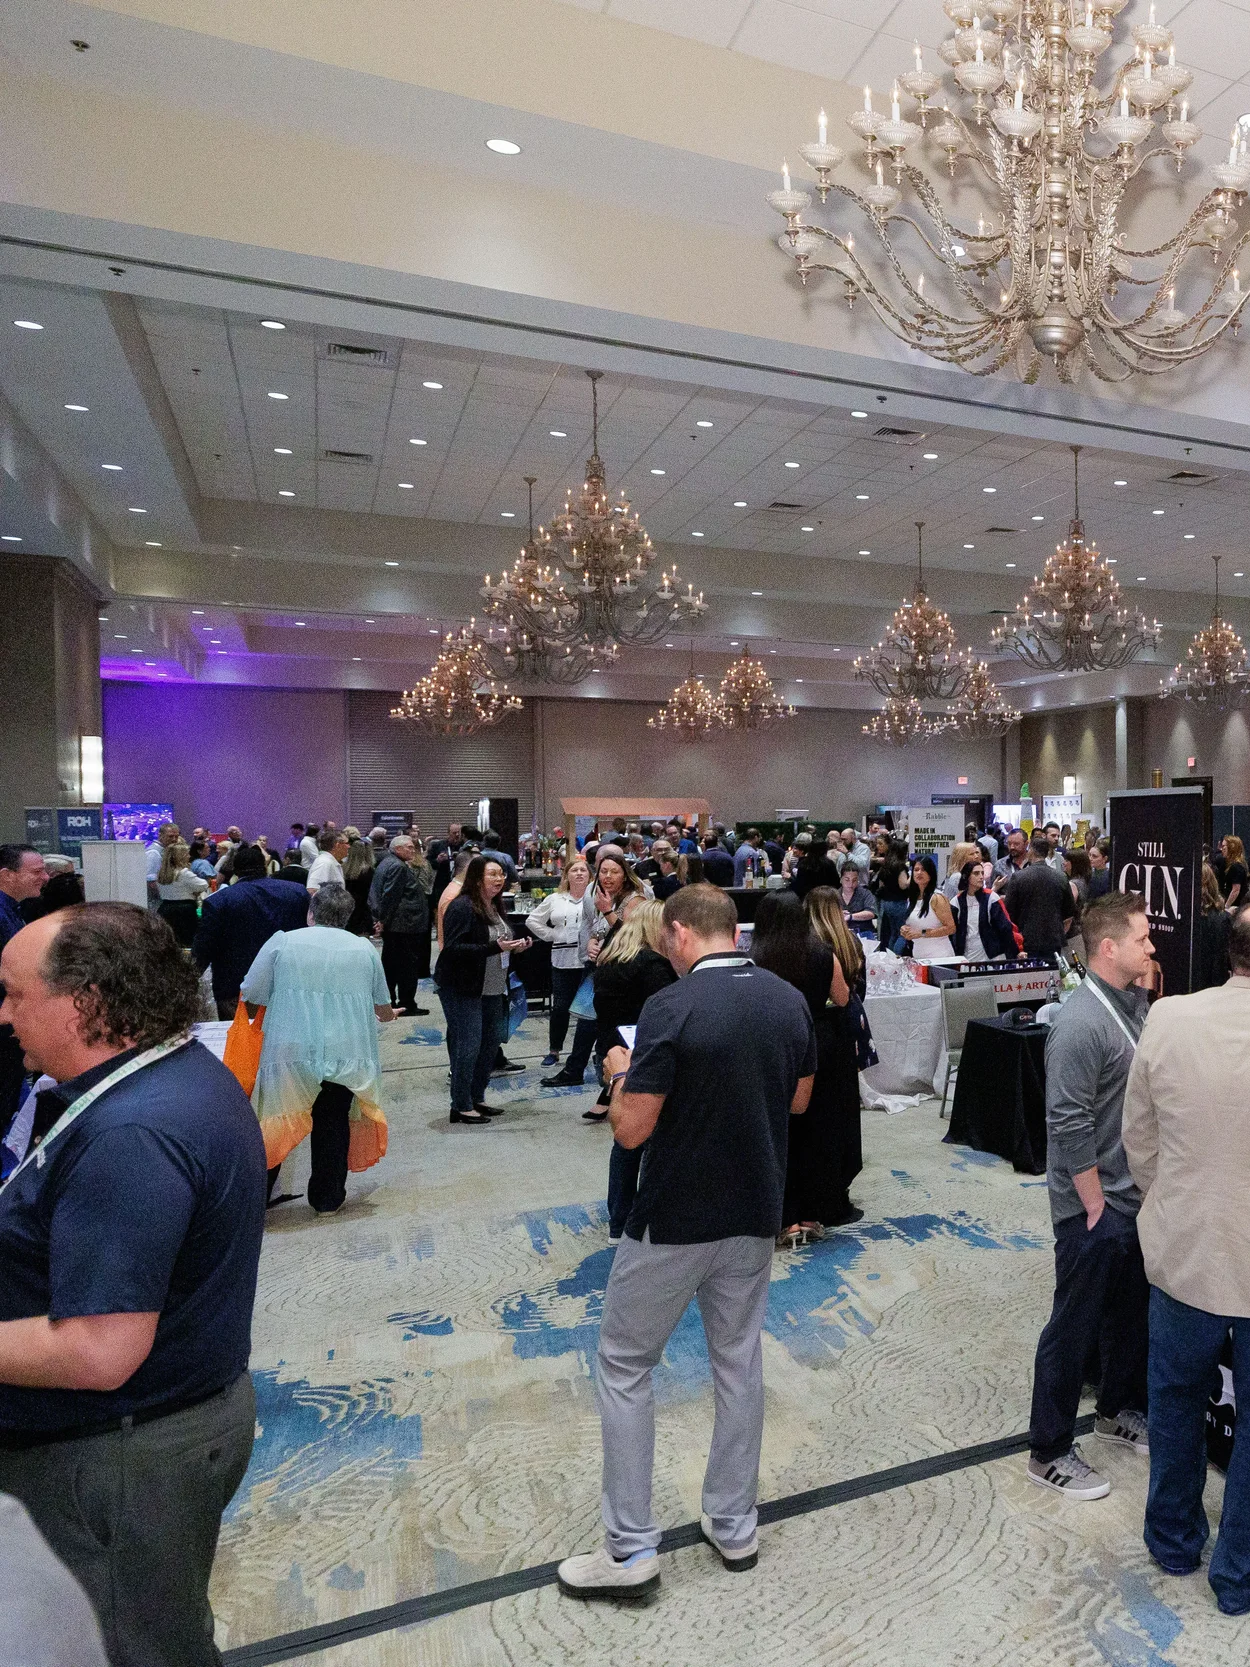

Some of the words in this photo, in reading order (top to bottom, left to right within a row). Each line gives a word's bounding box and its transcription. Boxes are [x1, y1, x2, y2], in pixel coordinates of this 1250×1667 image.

[67, 816, 92, 827] ROH
[1137, 842, 1166, 858] STILL
[1158, 923, 1174, 933] SNOOP
